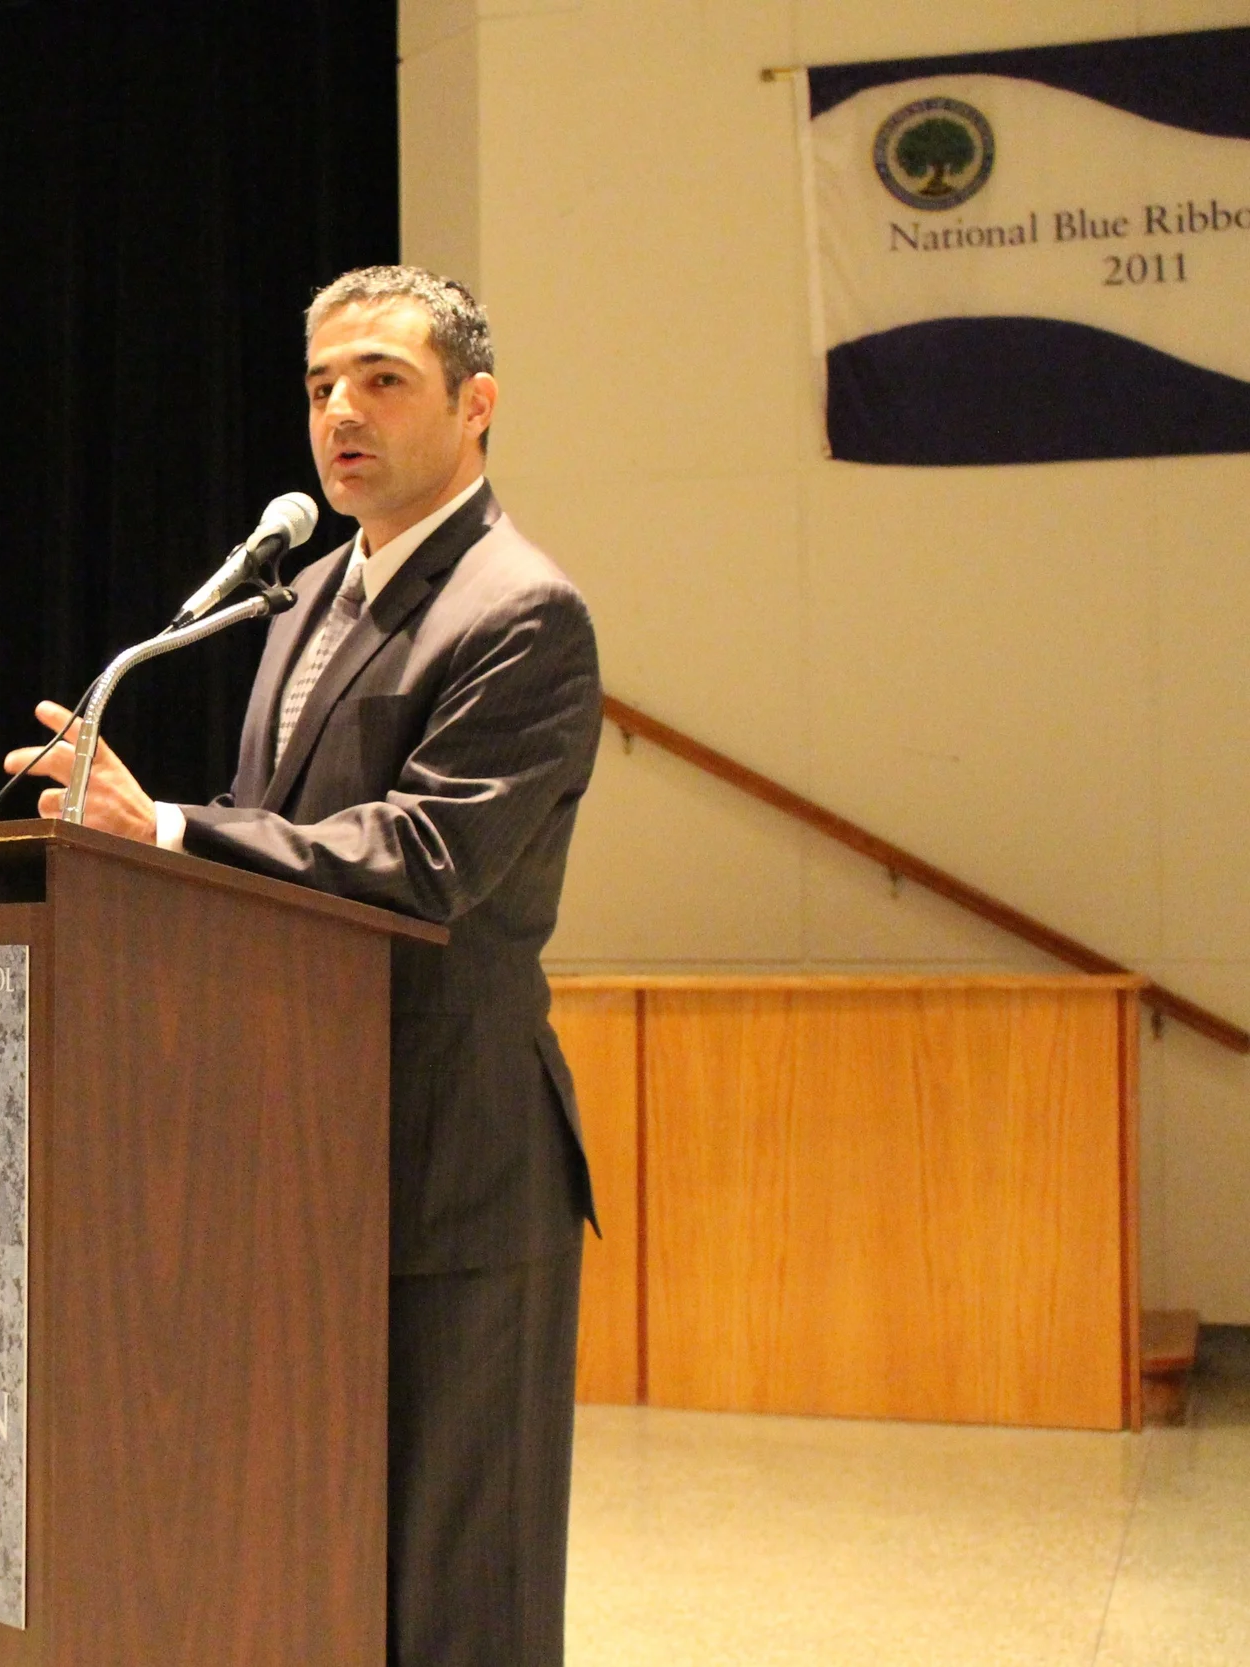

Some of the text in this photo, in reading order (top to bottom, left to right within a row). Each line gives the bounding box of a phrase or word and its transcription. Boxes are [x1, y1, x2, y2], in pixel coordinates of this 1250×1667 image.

[889, 212, 1038, 252] National
[1054, 207, 1129, 242] Blue
[1103, 252, 1188, 286] 2011
